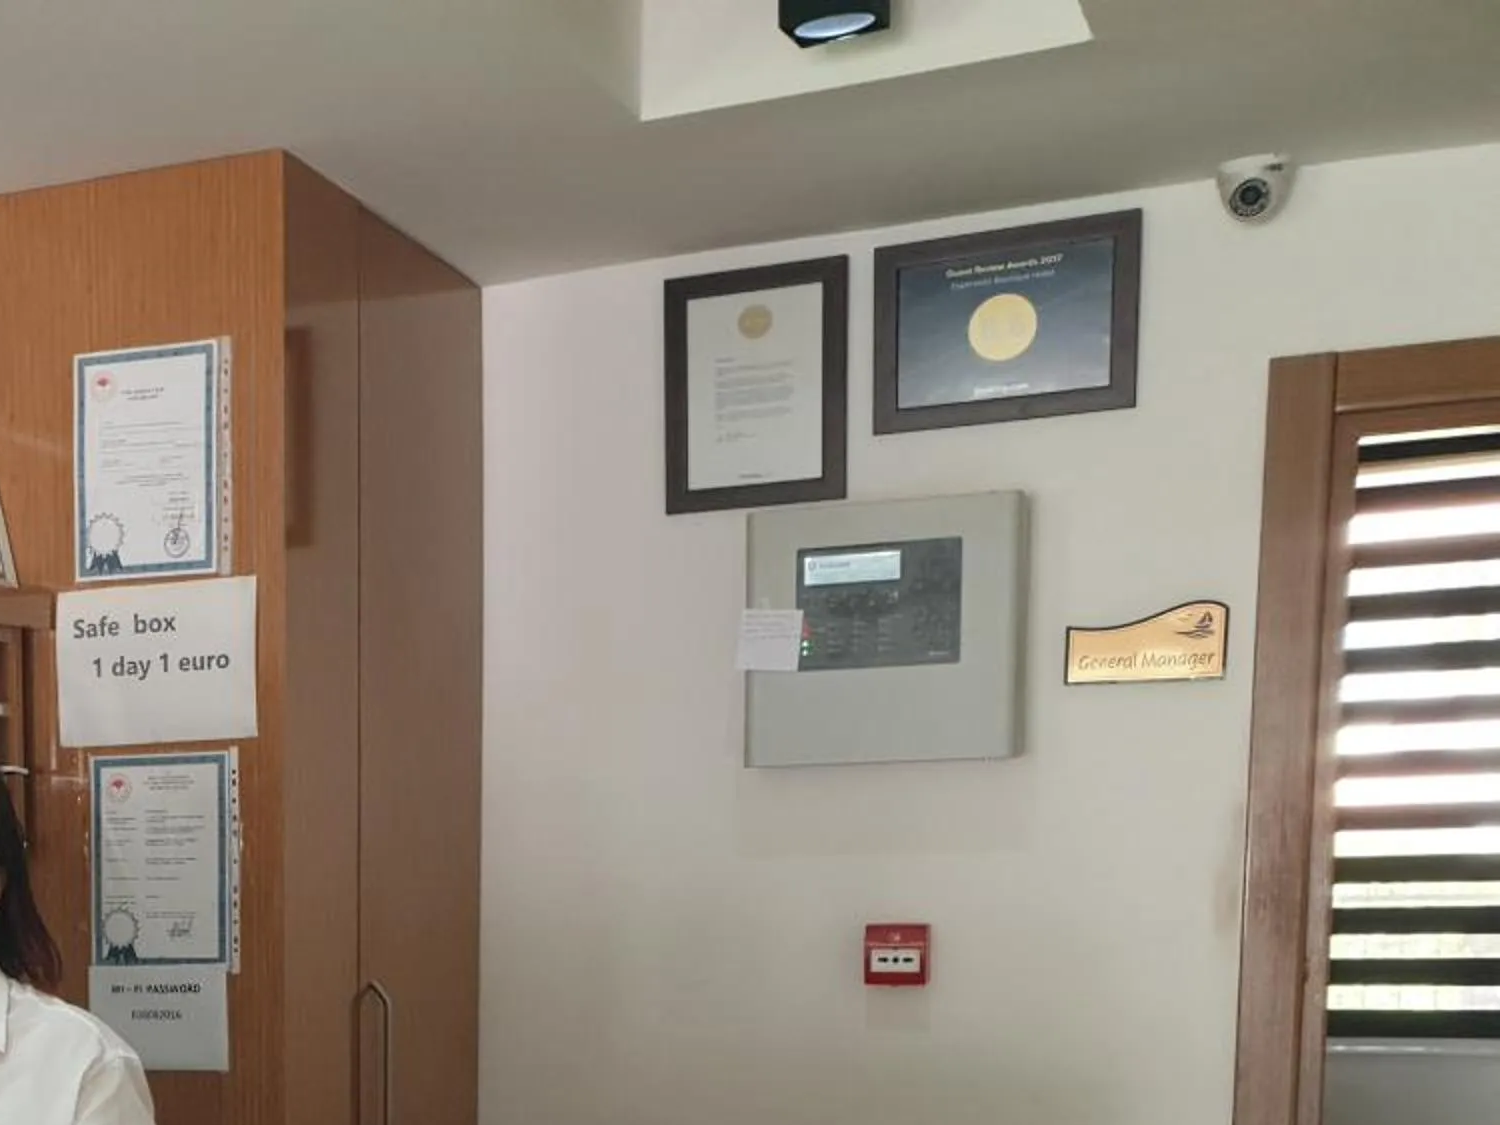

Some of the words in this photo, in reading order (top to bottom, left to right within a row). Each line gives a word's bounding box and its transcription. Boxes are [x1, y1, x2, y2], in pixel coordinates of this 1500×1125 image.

[72, 615, 120, 640] Safe
[133, 613, 177, 635] box
[92, 657, 102, 679] 1
[111, 655, 151, 681] day
[159, 652, 169, 673] 1
[178, 652, 230, 672] euro
[1078, 651, 1137, 671] General
[1140, 651, 1216, 672] Manager
[146, 982, 202, 994] PASSWORD
